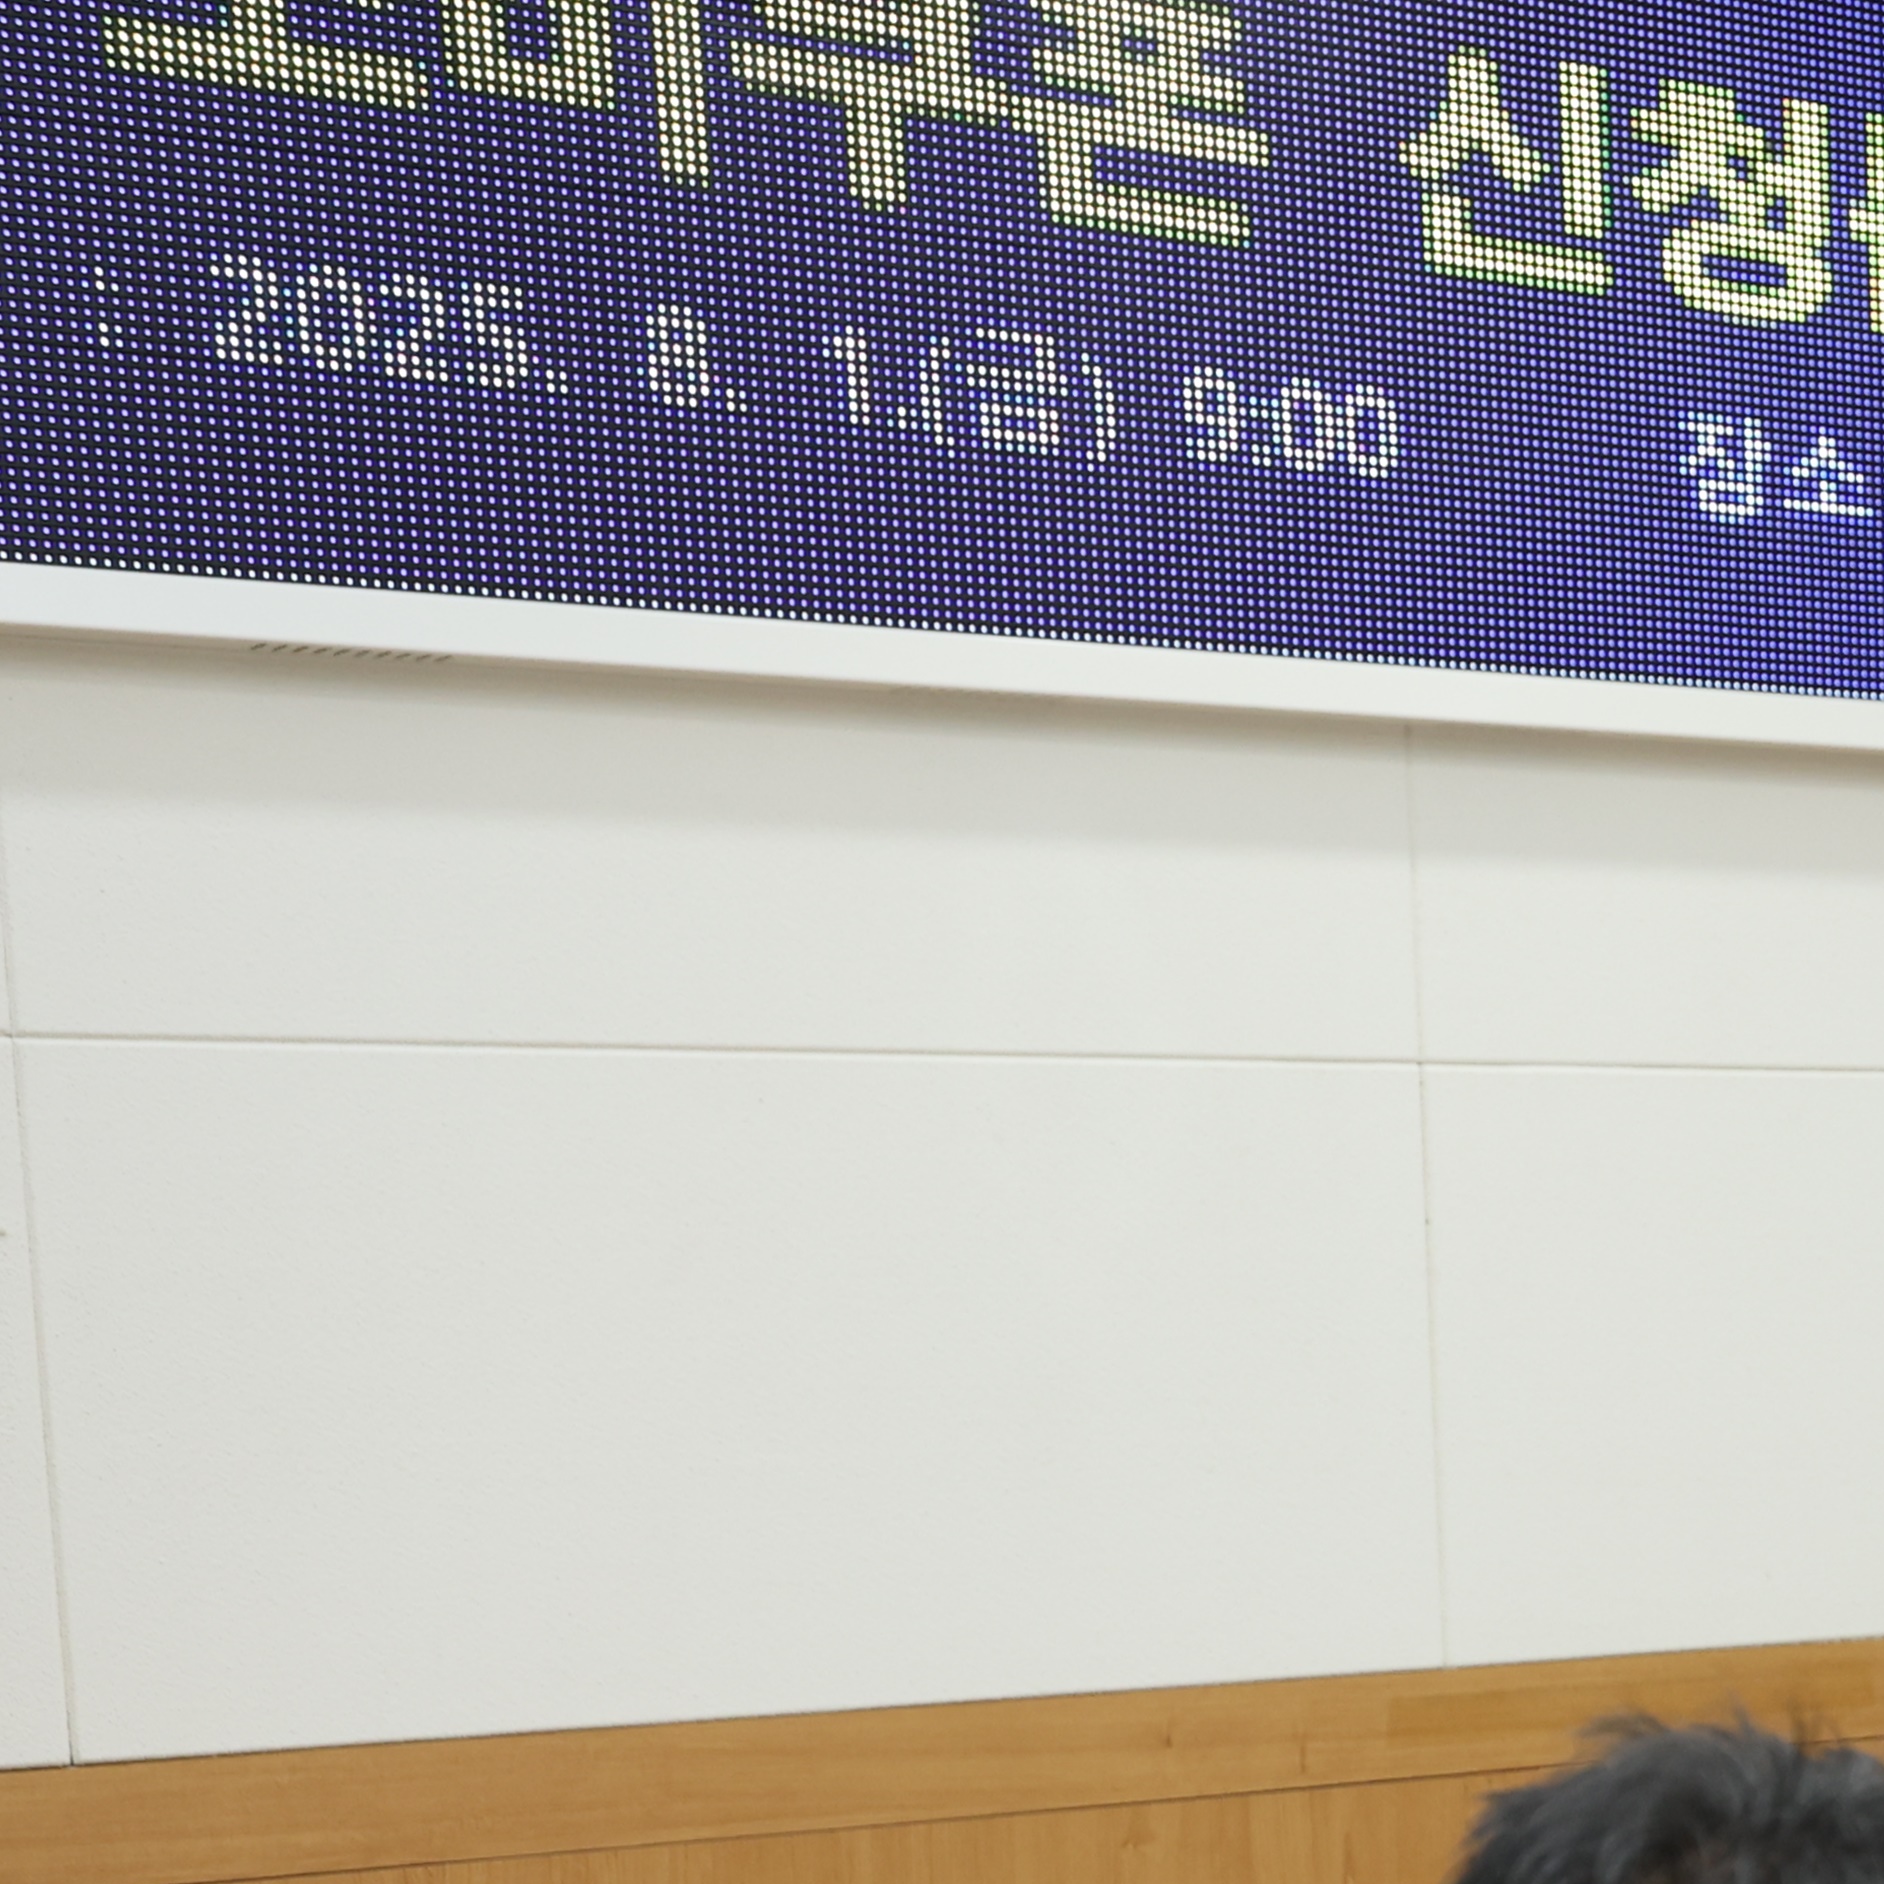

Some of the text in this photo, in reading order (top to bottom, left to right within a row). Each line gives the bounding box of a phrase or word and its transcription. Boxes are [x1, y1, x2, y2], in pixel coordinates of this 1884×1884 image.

[206, 250, 572, 396] 2025.
[1182, 364, 1400, 480] 9:00
[1676, 410, 1874, 525] 장소
